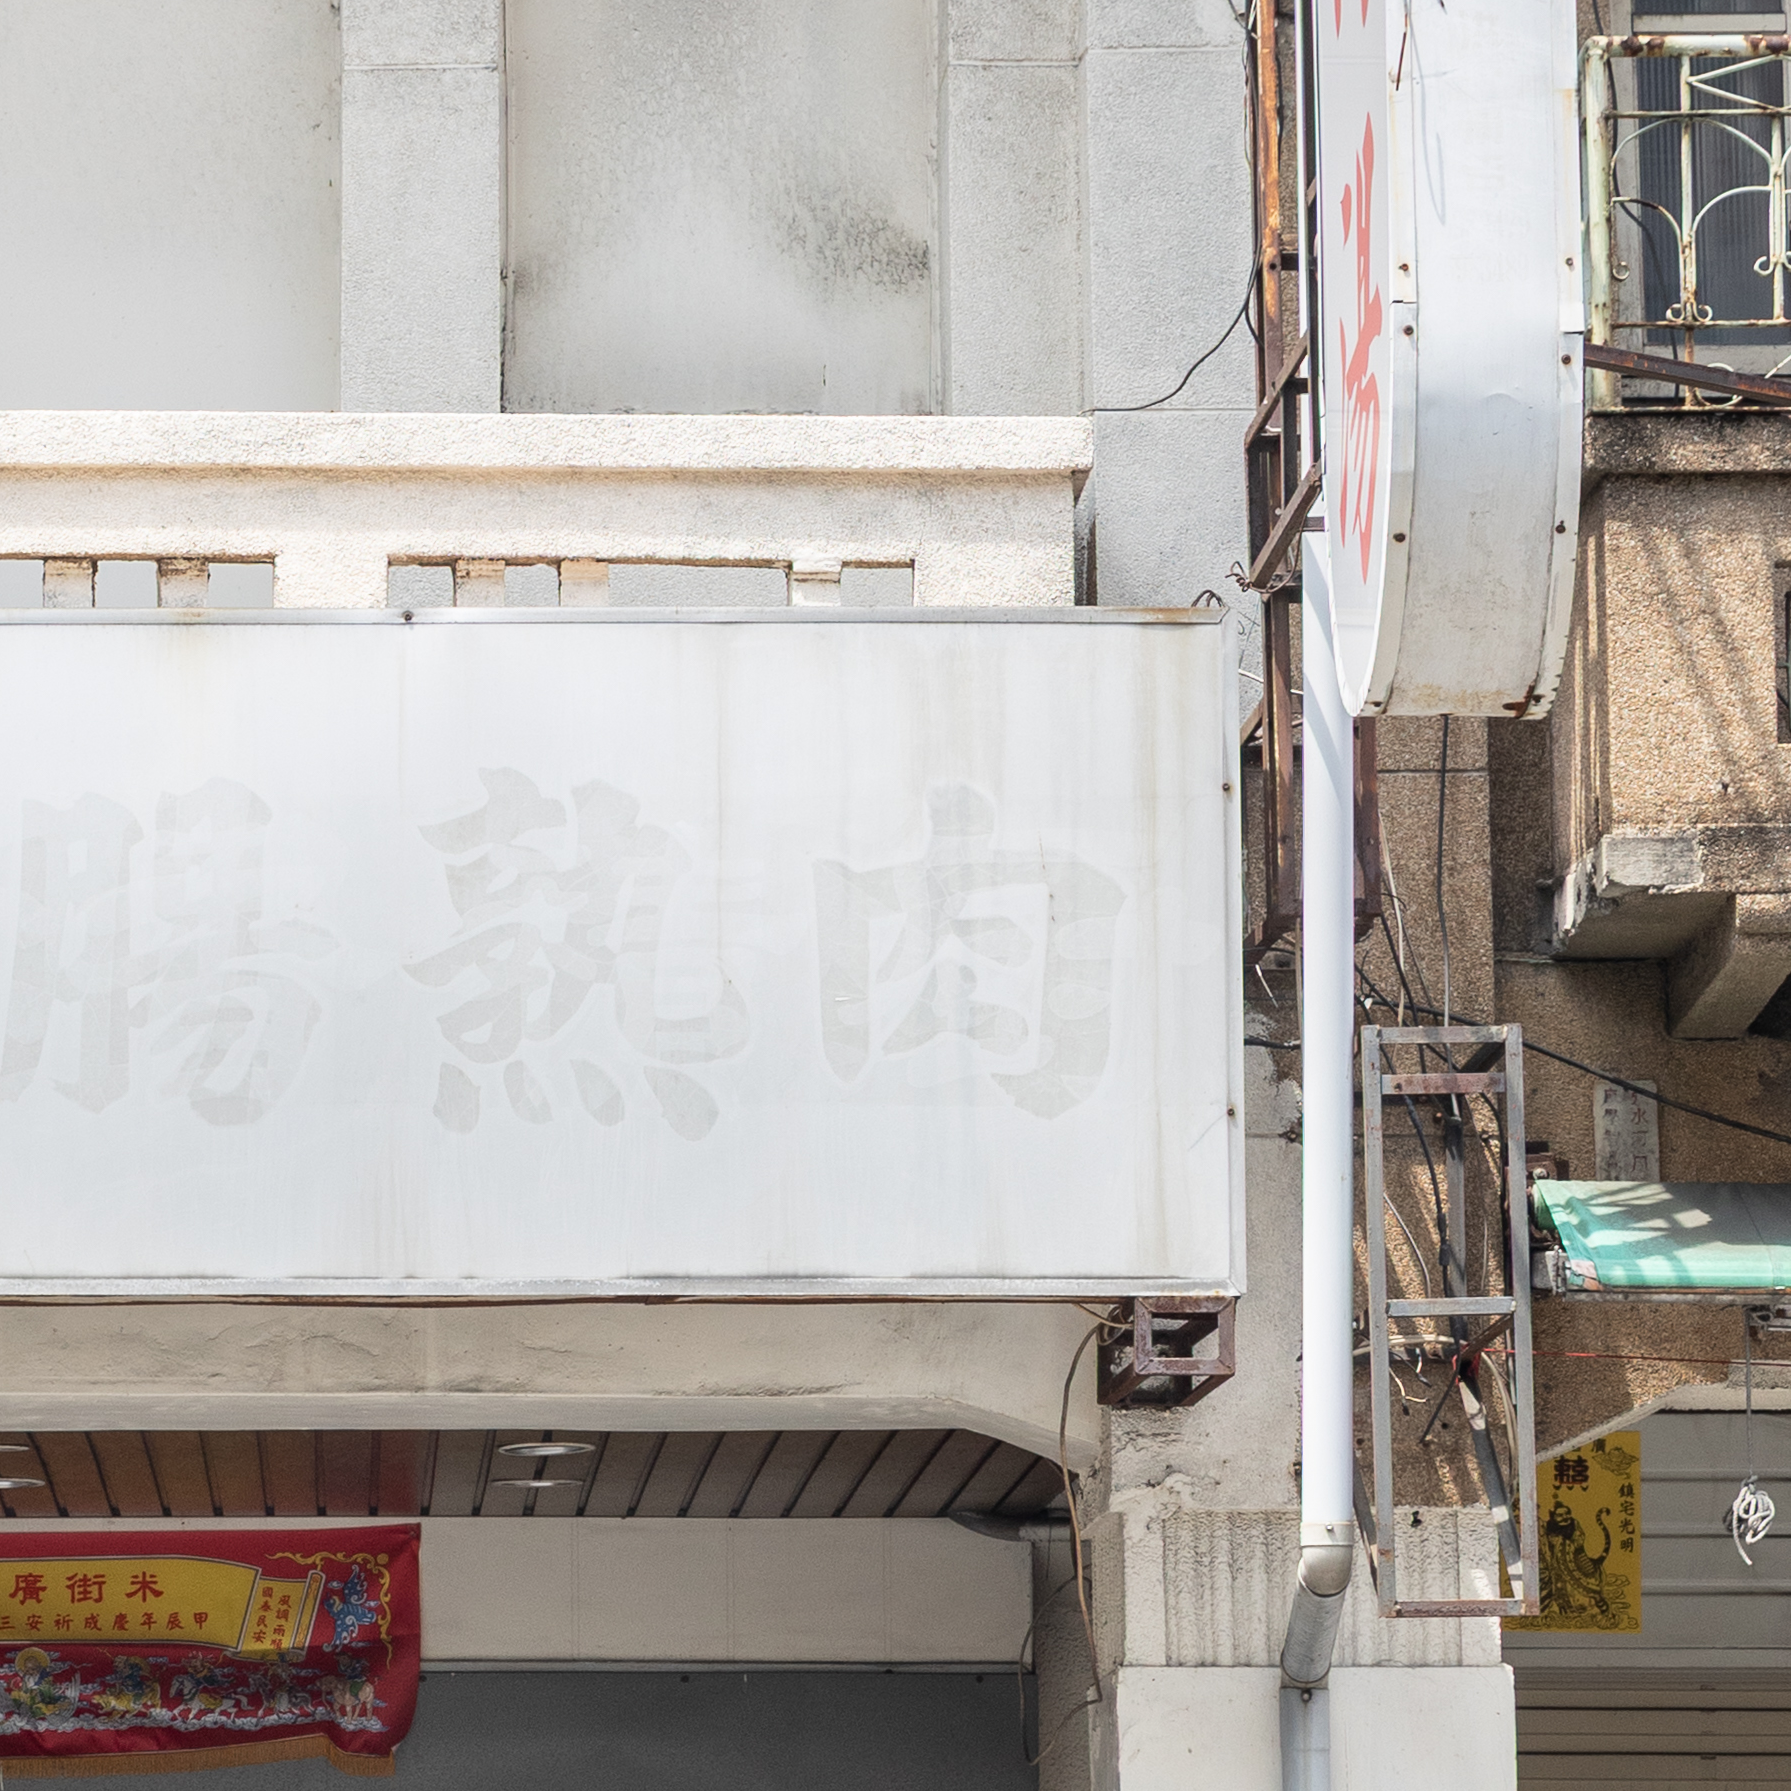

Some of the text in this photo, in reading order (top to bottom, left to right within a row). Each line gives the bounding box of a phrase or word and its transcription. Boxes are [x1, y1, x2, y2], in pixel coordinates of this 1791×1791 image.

[1618, 1482, 1636, 1554] 鎮宅光明
[252, 1586, 274, 1644] 國泰民安
[270, 1594, 292, 1651] 風調雨順
